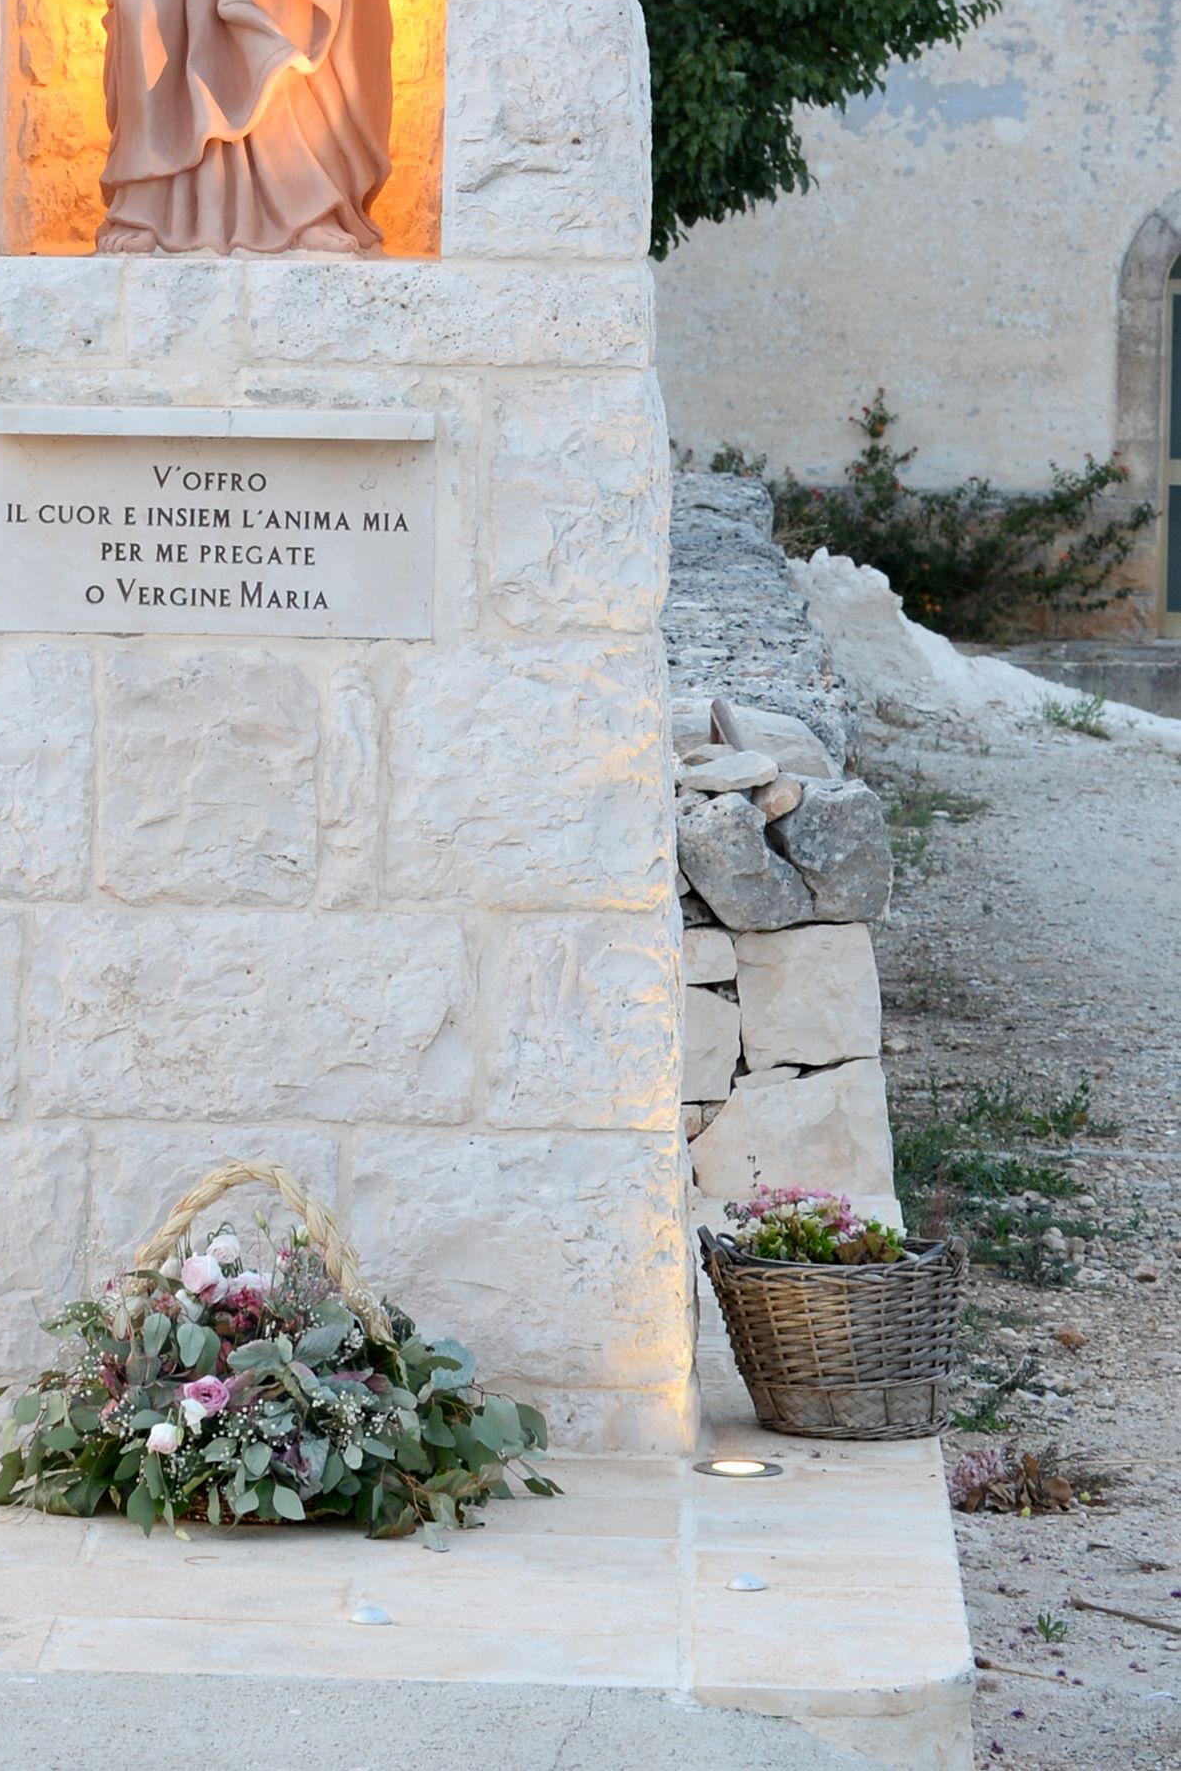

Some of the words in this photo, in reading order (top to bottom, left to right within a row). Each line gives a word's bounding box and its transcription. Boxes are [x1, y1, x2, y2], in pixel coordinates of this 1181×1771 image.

[152, 465, 267, 492] V'OFFRO
[6, 502, 28, 523] IL
[38, 504, 113, 526] CUOR
[124, 506, 137, 526] E
[147, 507, 231, 528] INSIEM
[242, 509, 351, 531] L'ANIMA
[362, 512, 409, 532] MIA
[101, 541, 144, 562] PER
[155, 543, 189, 563] ME
[199, 544, 316, 566] PREGATE
[85, 584, 105, 605] O
[115, 578, 232, 608] VERGINE
[240, 580, 329, 610] MARIA
